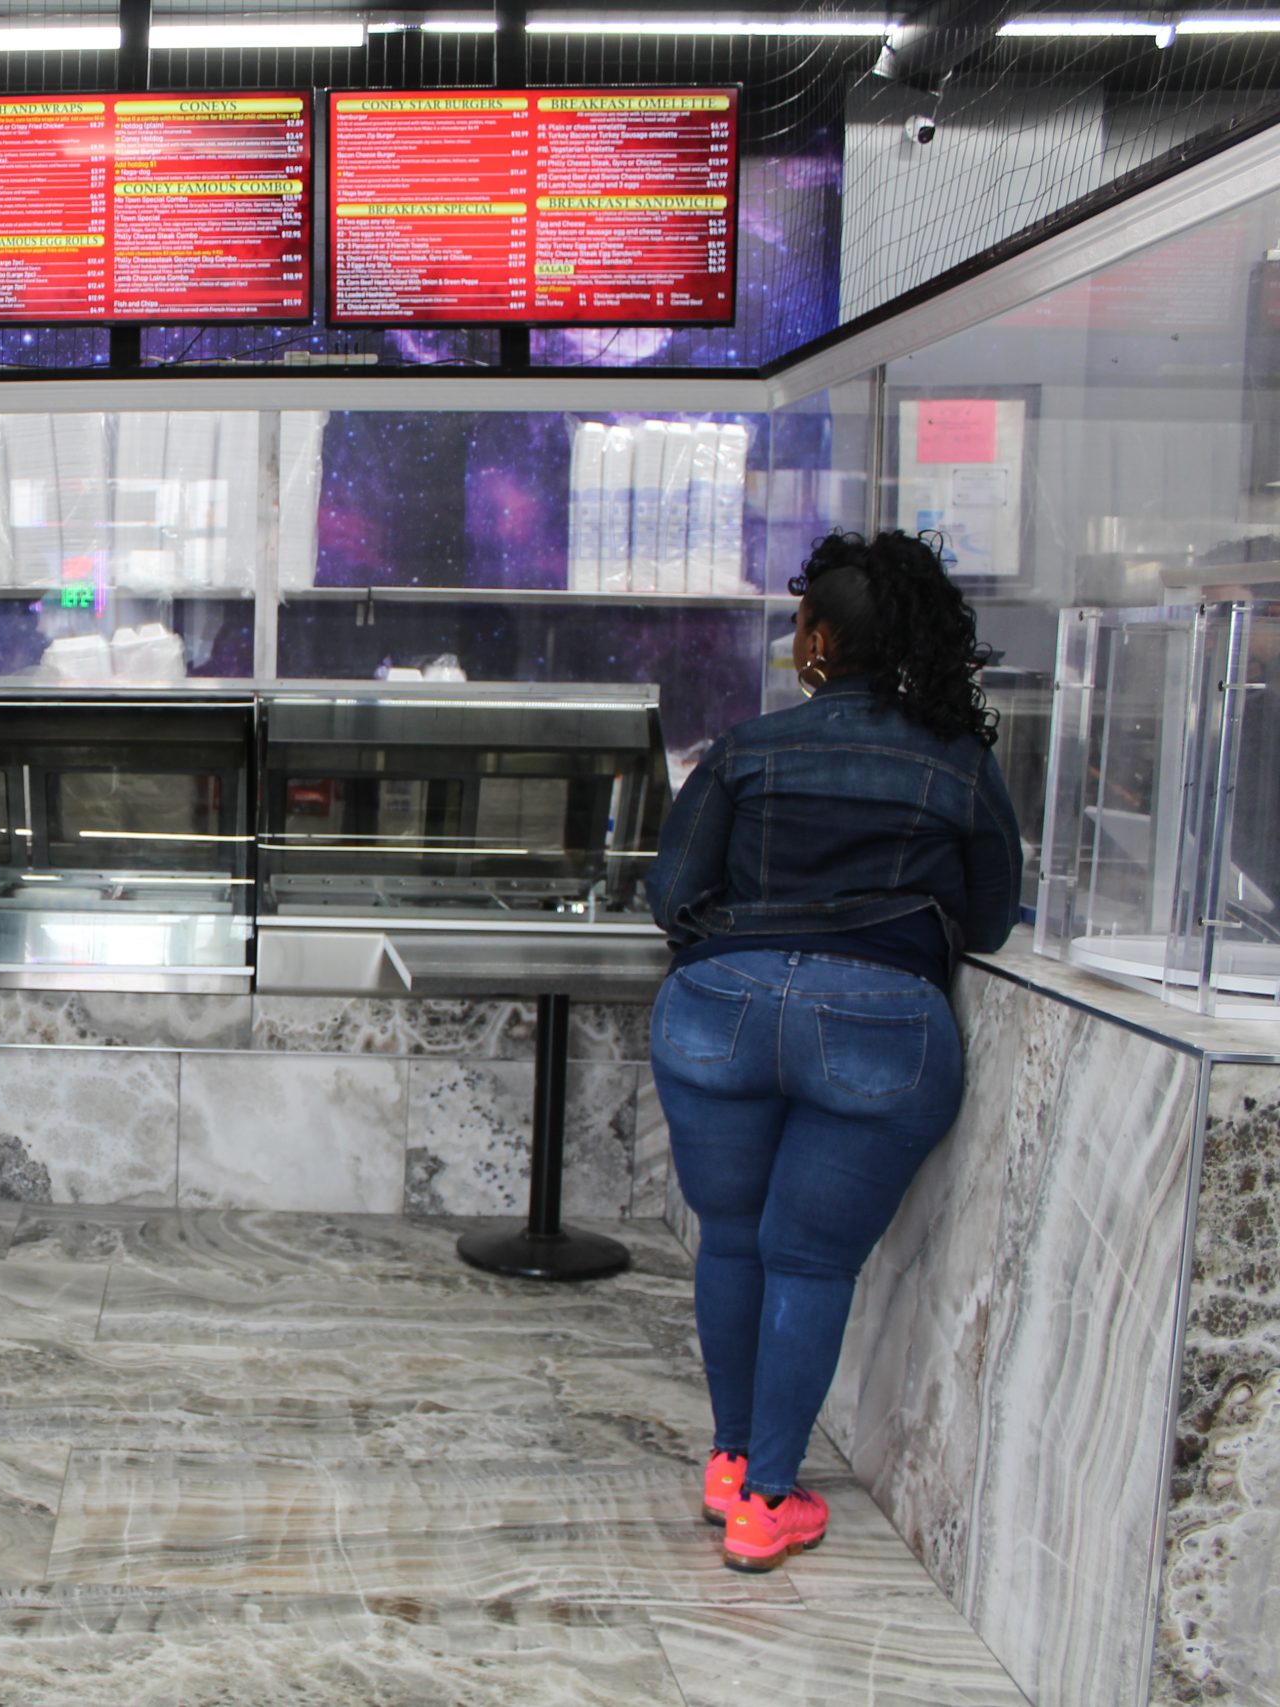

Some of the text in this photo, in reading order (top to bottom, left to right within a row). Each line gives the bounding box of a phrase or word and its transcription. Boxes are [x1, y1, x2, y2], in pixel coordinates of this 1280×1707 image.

[9, 104, 37, 114] AND
[41, 103, 83, 113] WRAPS
[180, 101, 237, 112] CONEYS
[362, 100, 503, 110] CONEY STAR BURGERS
[551, 98, 717, 109] BREAKFAST OMELETTE
[121, 135, 141, 143] Coney
[142, 135, 163, 143] Hotdog
[123, 181, 293, 194] CONEY FAMOUS COMBO
[549, 197, 714, 208] BREAKFAST SANDWICH
[368, 204, 495, 214] BREAKFAST SPECIAL
[40, 236, 62, 246] EGG
[66, 236, 98, 246] ROLLS
[114, 233, 131, 241] Philly
[141, 300, 158, 308] Chips
